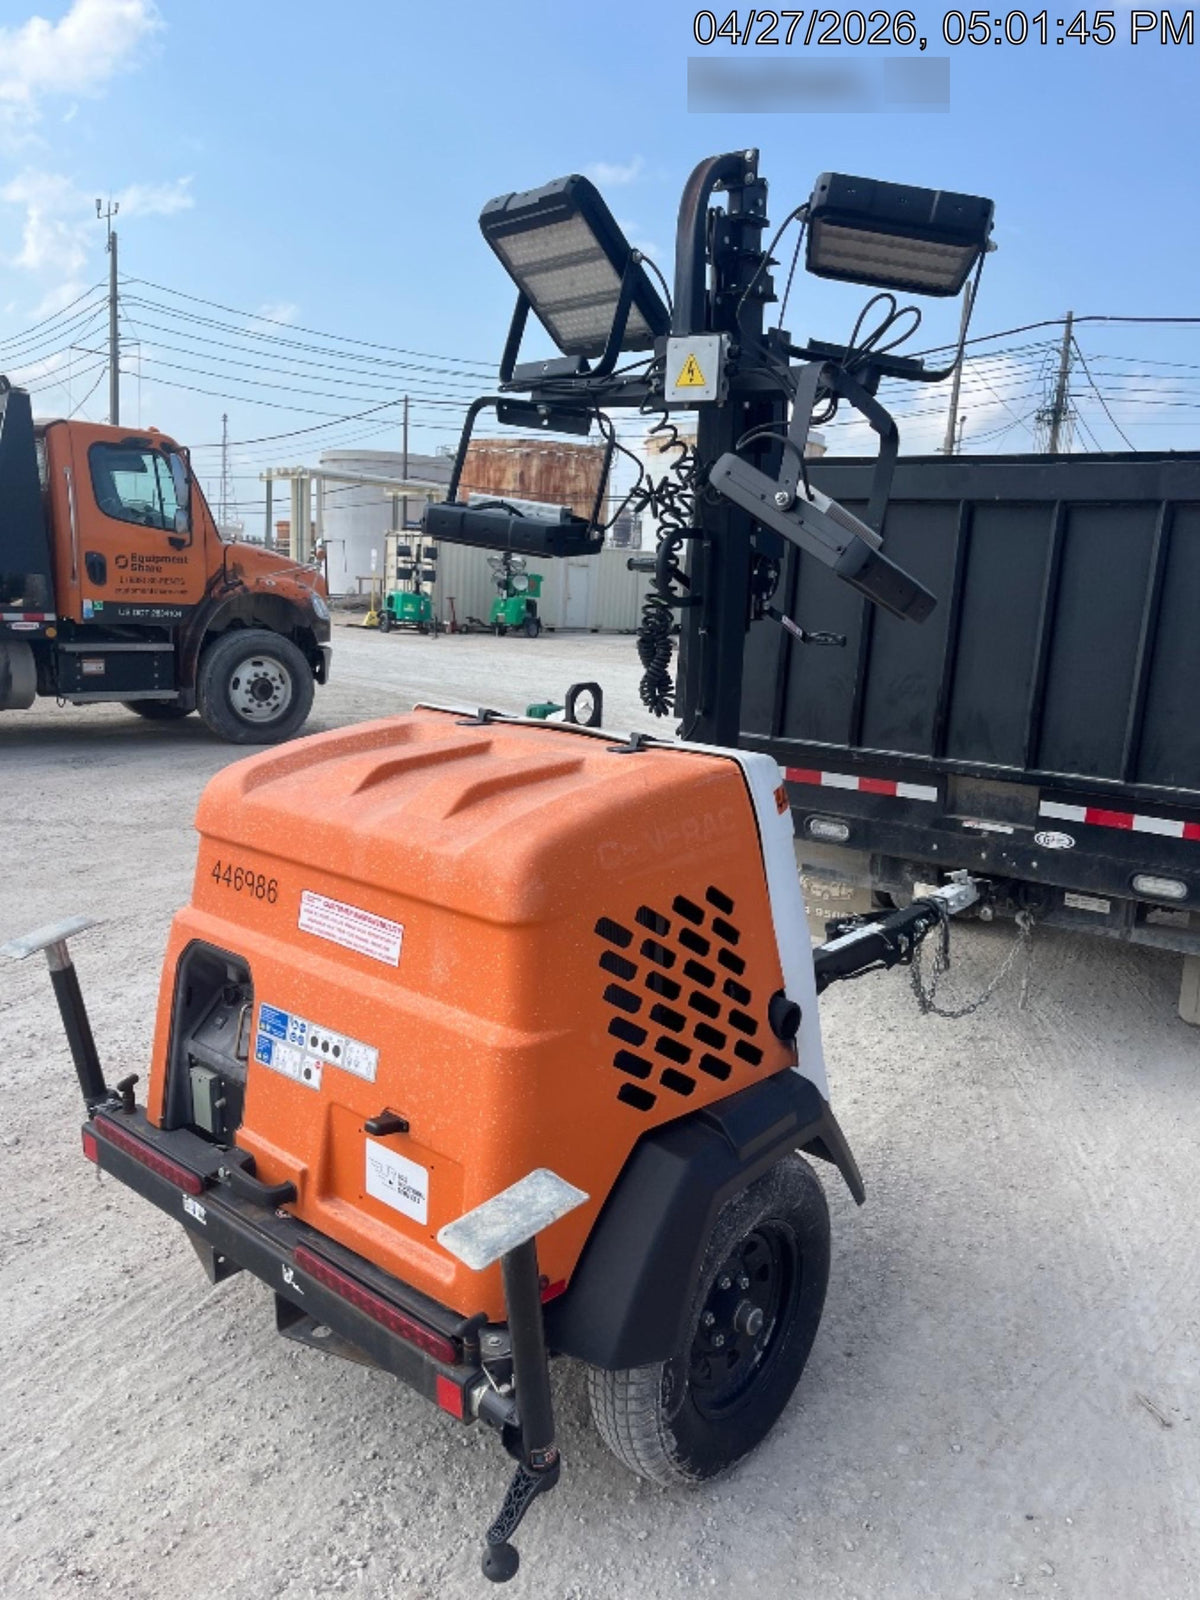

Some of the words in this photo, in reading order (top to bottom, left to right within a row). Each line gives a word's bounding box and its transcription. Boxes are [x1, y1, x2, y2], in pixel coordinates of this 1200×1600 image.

[131, 553, 188, 564] Equipment
[131, 563, 162, 572] Share
[211, 860, 278, 904] 446986
